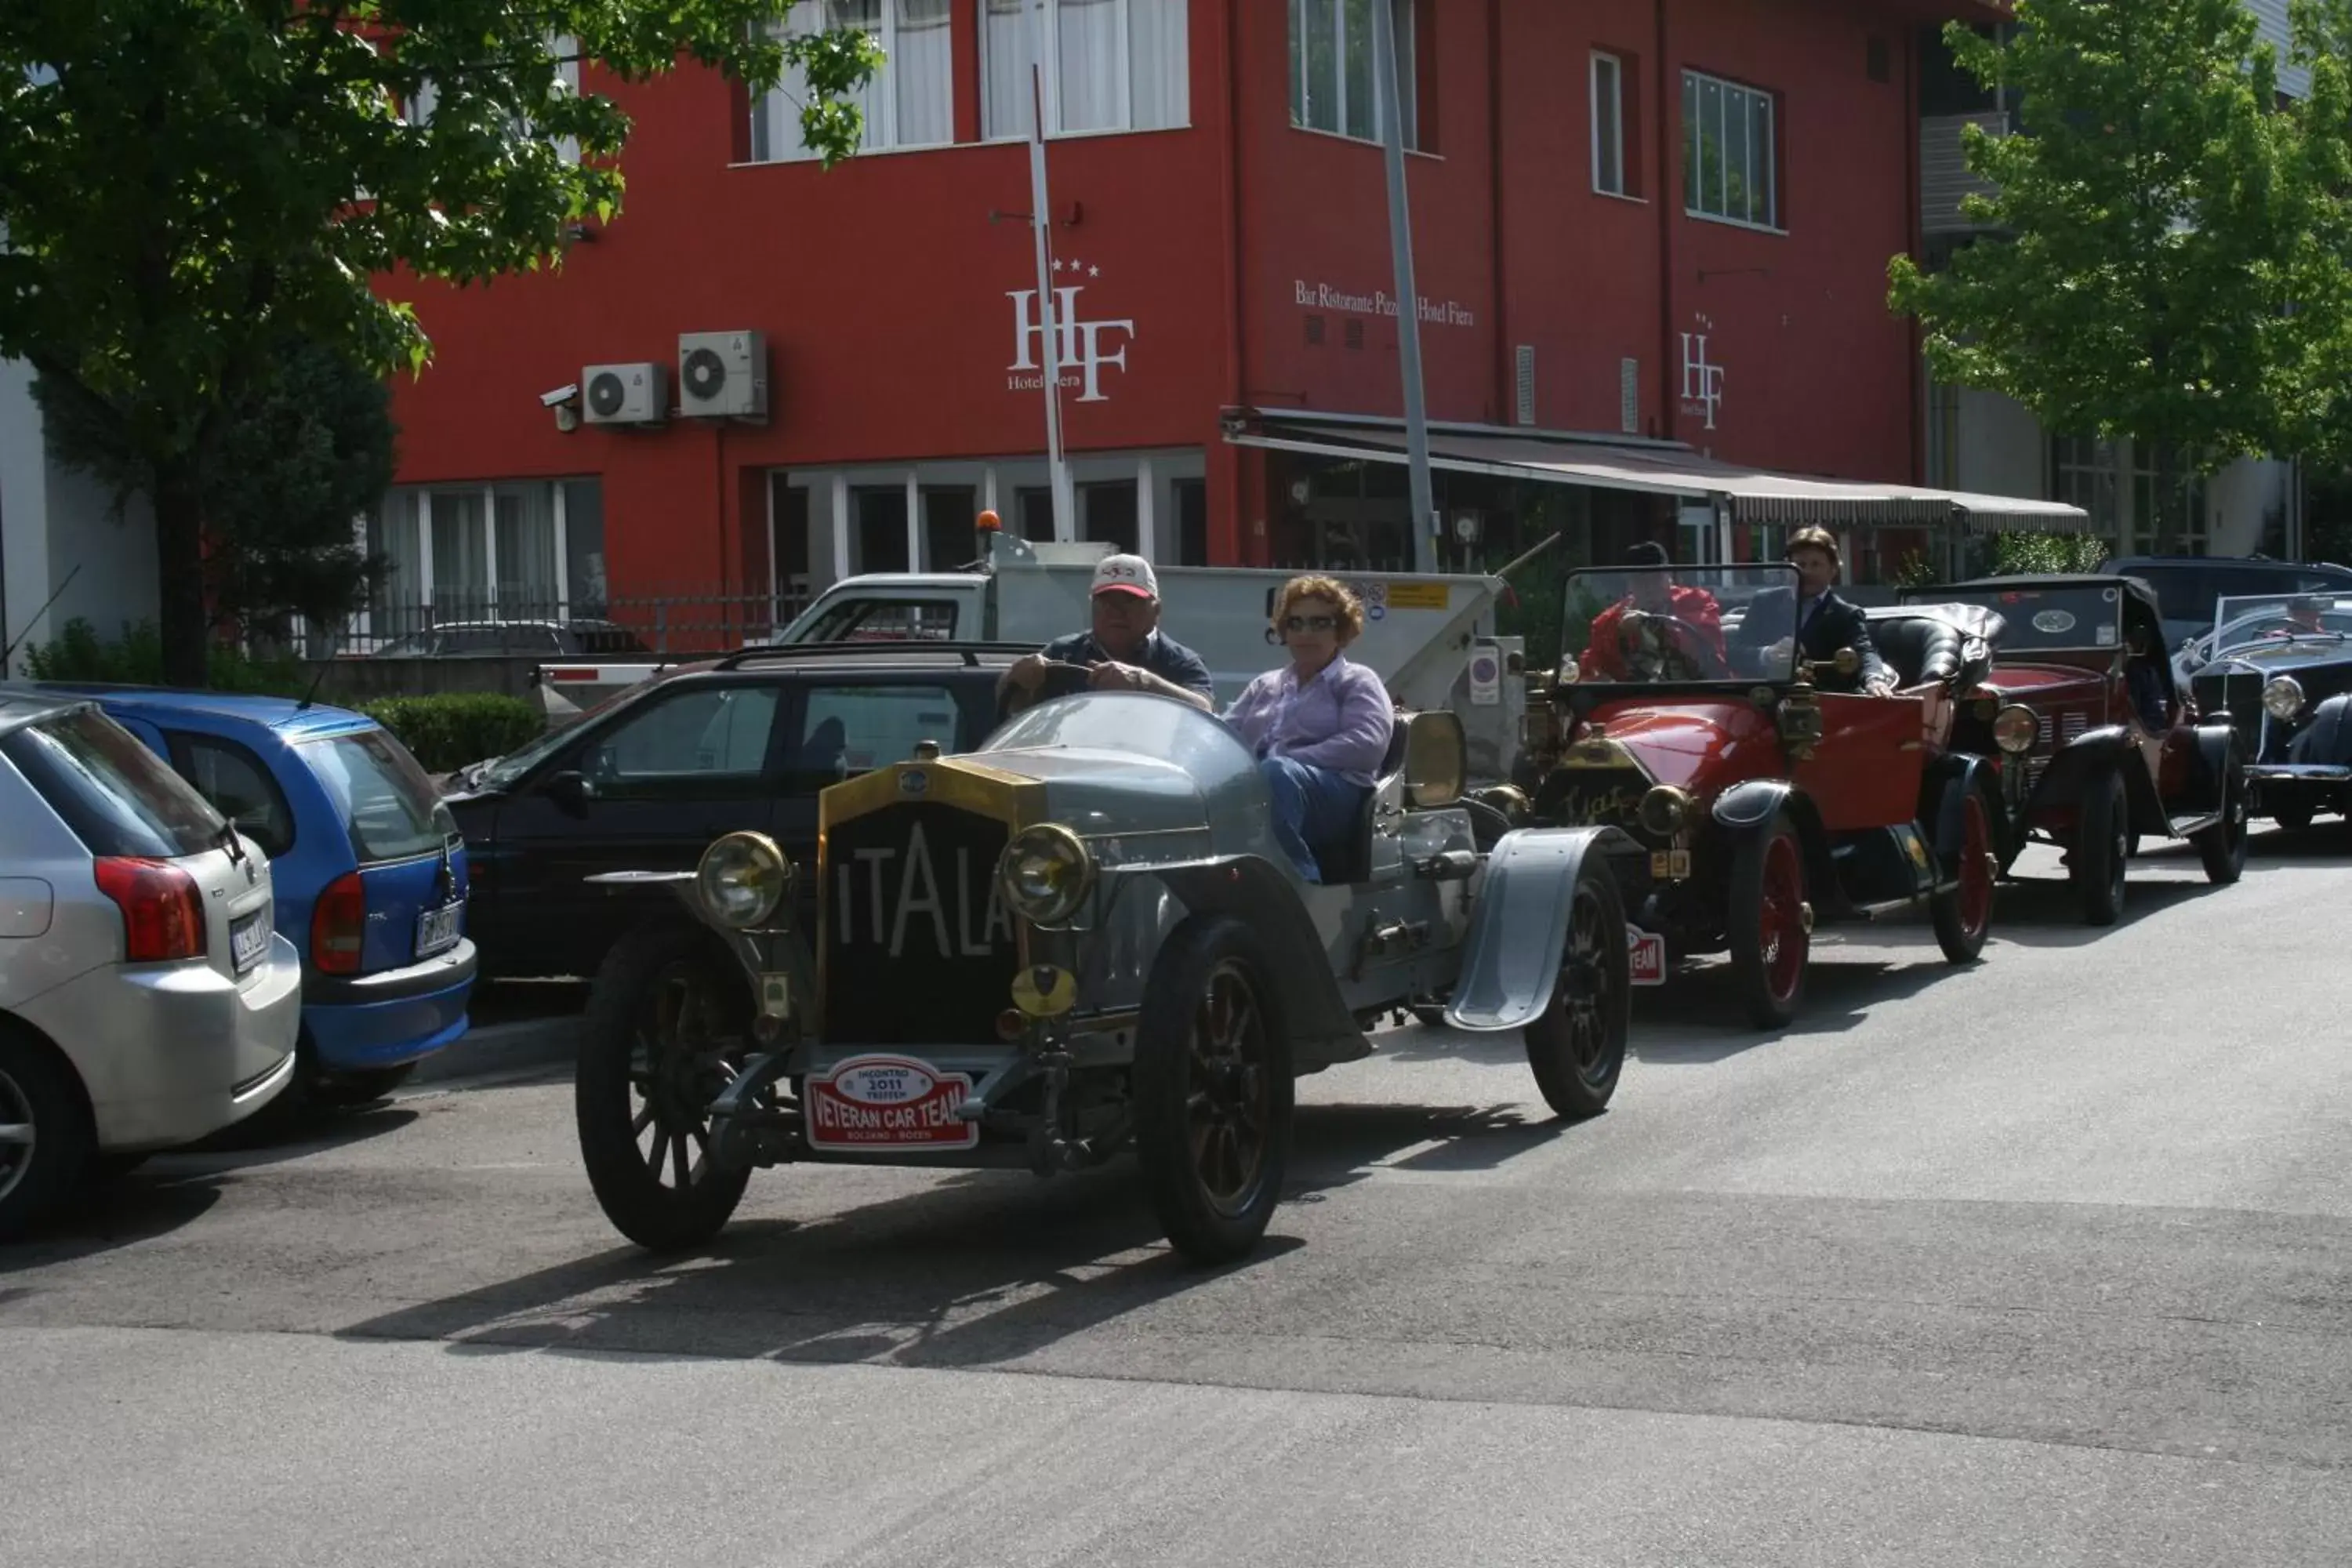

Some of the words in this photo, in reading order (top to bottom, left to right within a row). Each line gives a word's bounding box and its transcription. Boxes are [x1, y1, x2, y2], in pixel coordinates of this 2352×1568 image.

[1295, 280, 1316, 305] Bar
[1319, 283, 1373, 313] Ristorante
[1417, 297, 1446, 323] Hotel
[1448, 300, 1473, 326] Fiera
[1007, 375, 1044, 390] Hotel
[837, 820, 1012, 958] ITALA
[812, 1085, 880, 1129] VETERAN
[883, 1106, 917, 1129] CAR
[918, 1083, 964, 1127] TEAM
[869, 1079, 902, 1091] 2011
